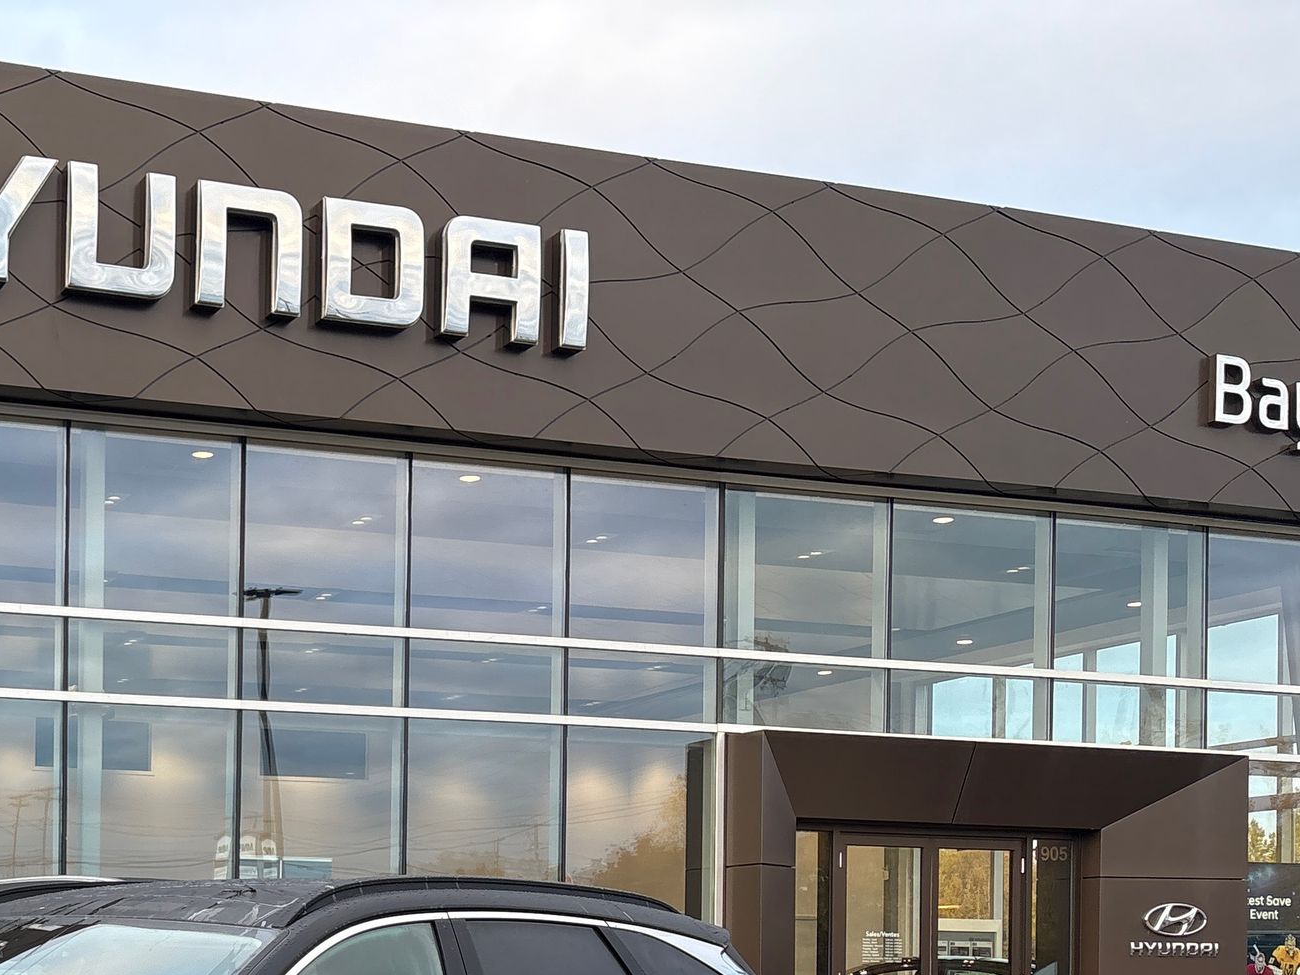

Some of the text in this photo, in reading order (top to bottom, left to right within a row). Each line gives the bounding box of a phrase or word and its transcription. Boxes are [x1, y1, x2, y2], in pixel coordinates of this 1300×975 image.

[1040, 846, 1068, 861] 905
[1247, 895, 1292, 907] est Save
[1249, 908, 1279, 920] Event
[1129, 941, 1219, 957] HYUNDAI
